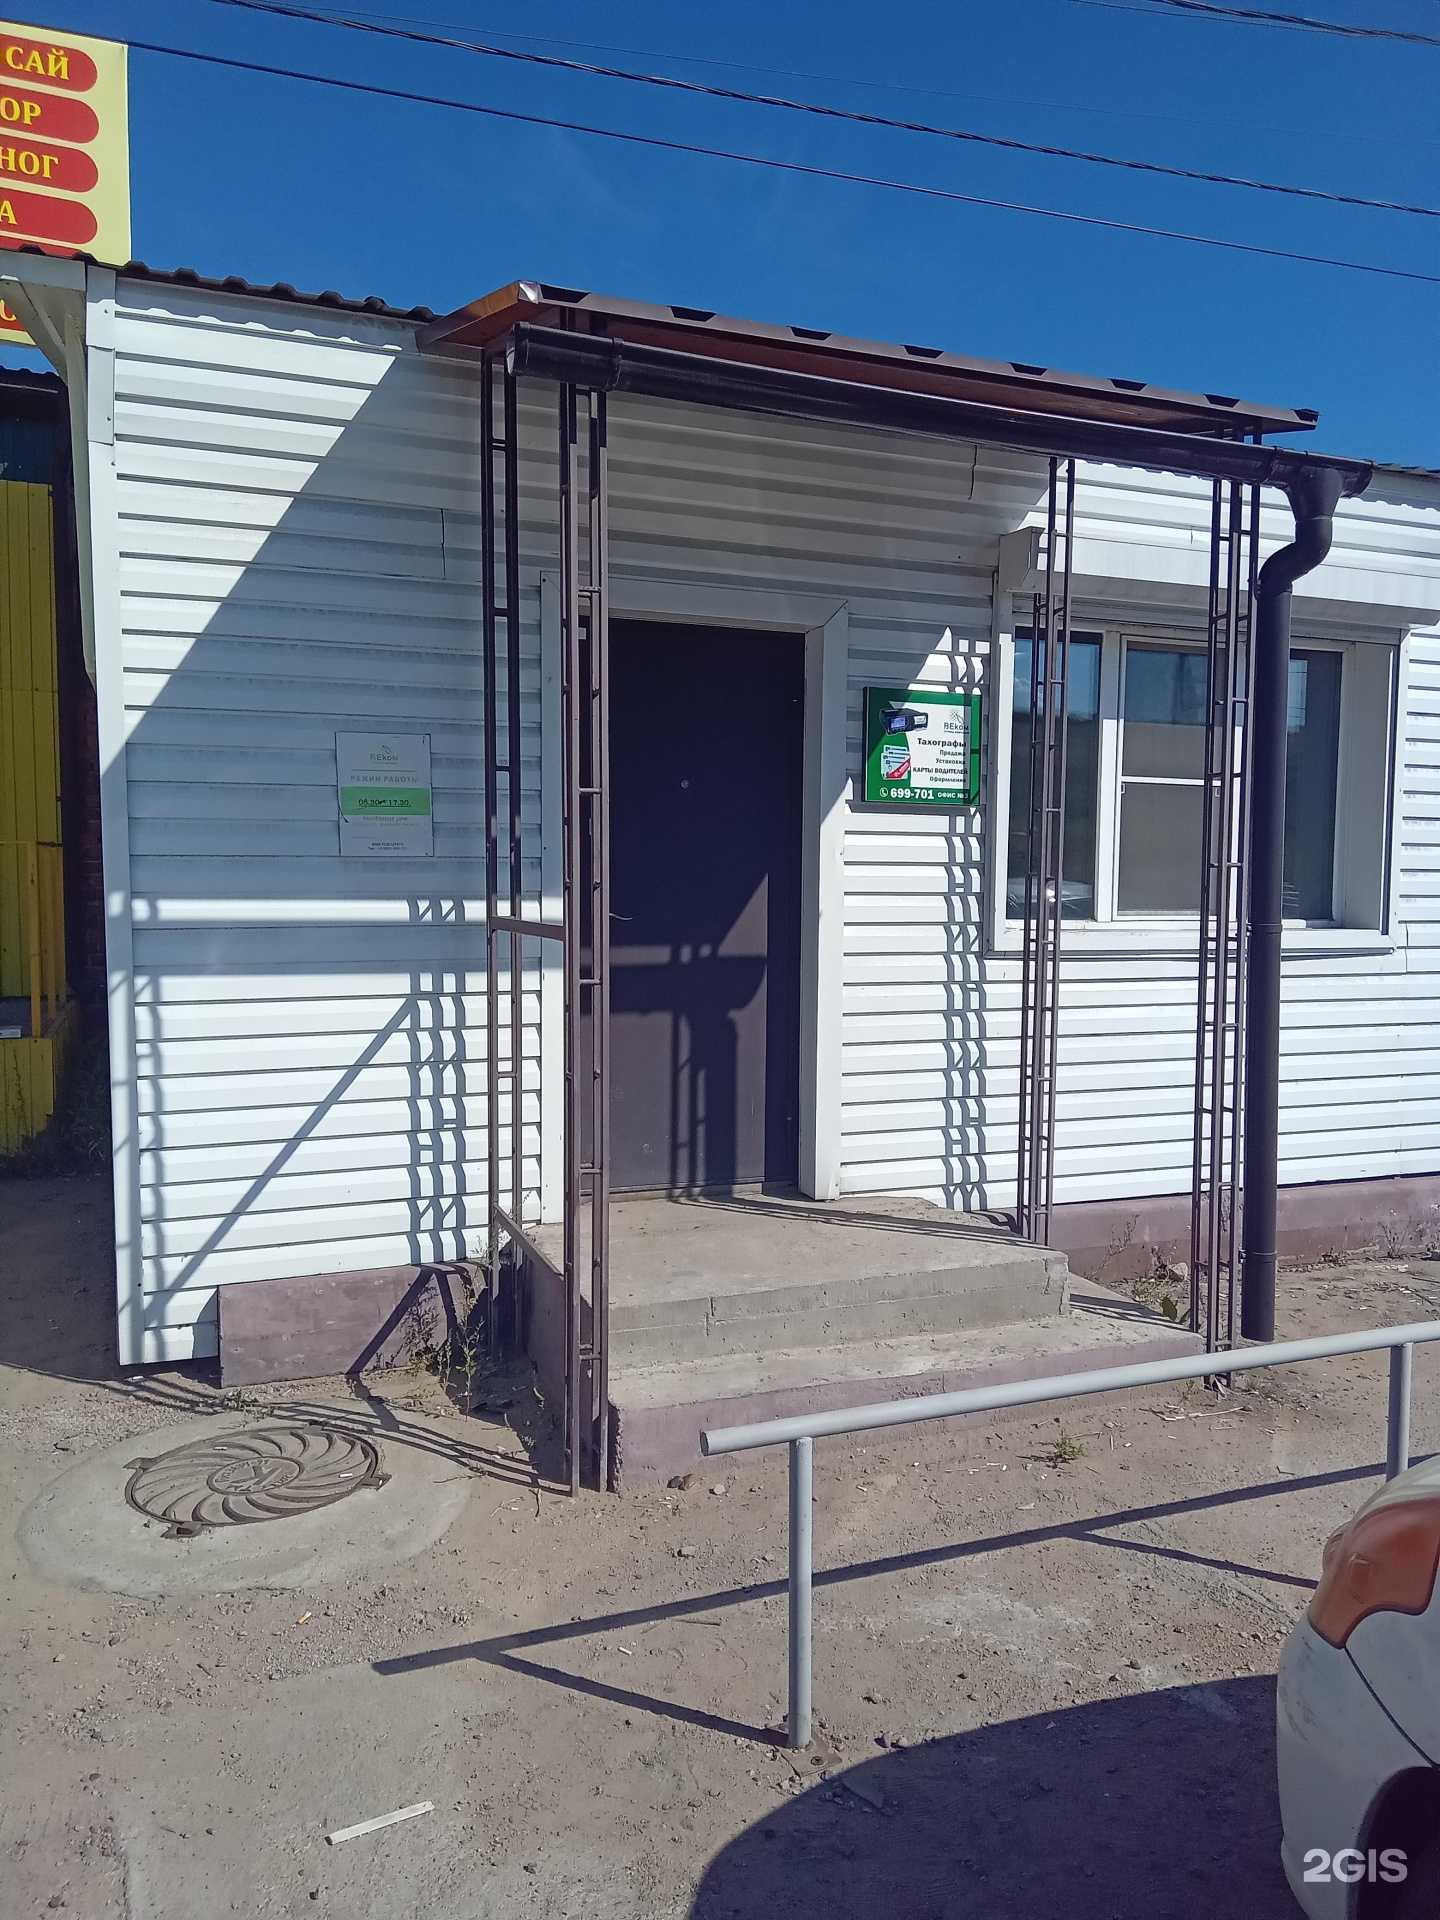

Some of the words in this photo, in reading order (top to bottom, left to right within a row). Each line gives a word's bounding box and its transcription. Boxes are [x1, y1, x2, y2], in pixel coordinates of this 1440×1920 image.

[5, 46, 70, 81] САЙ
[917, 737, 967, 748] Тахографы
[890, 787, 935, 800] 699-701
